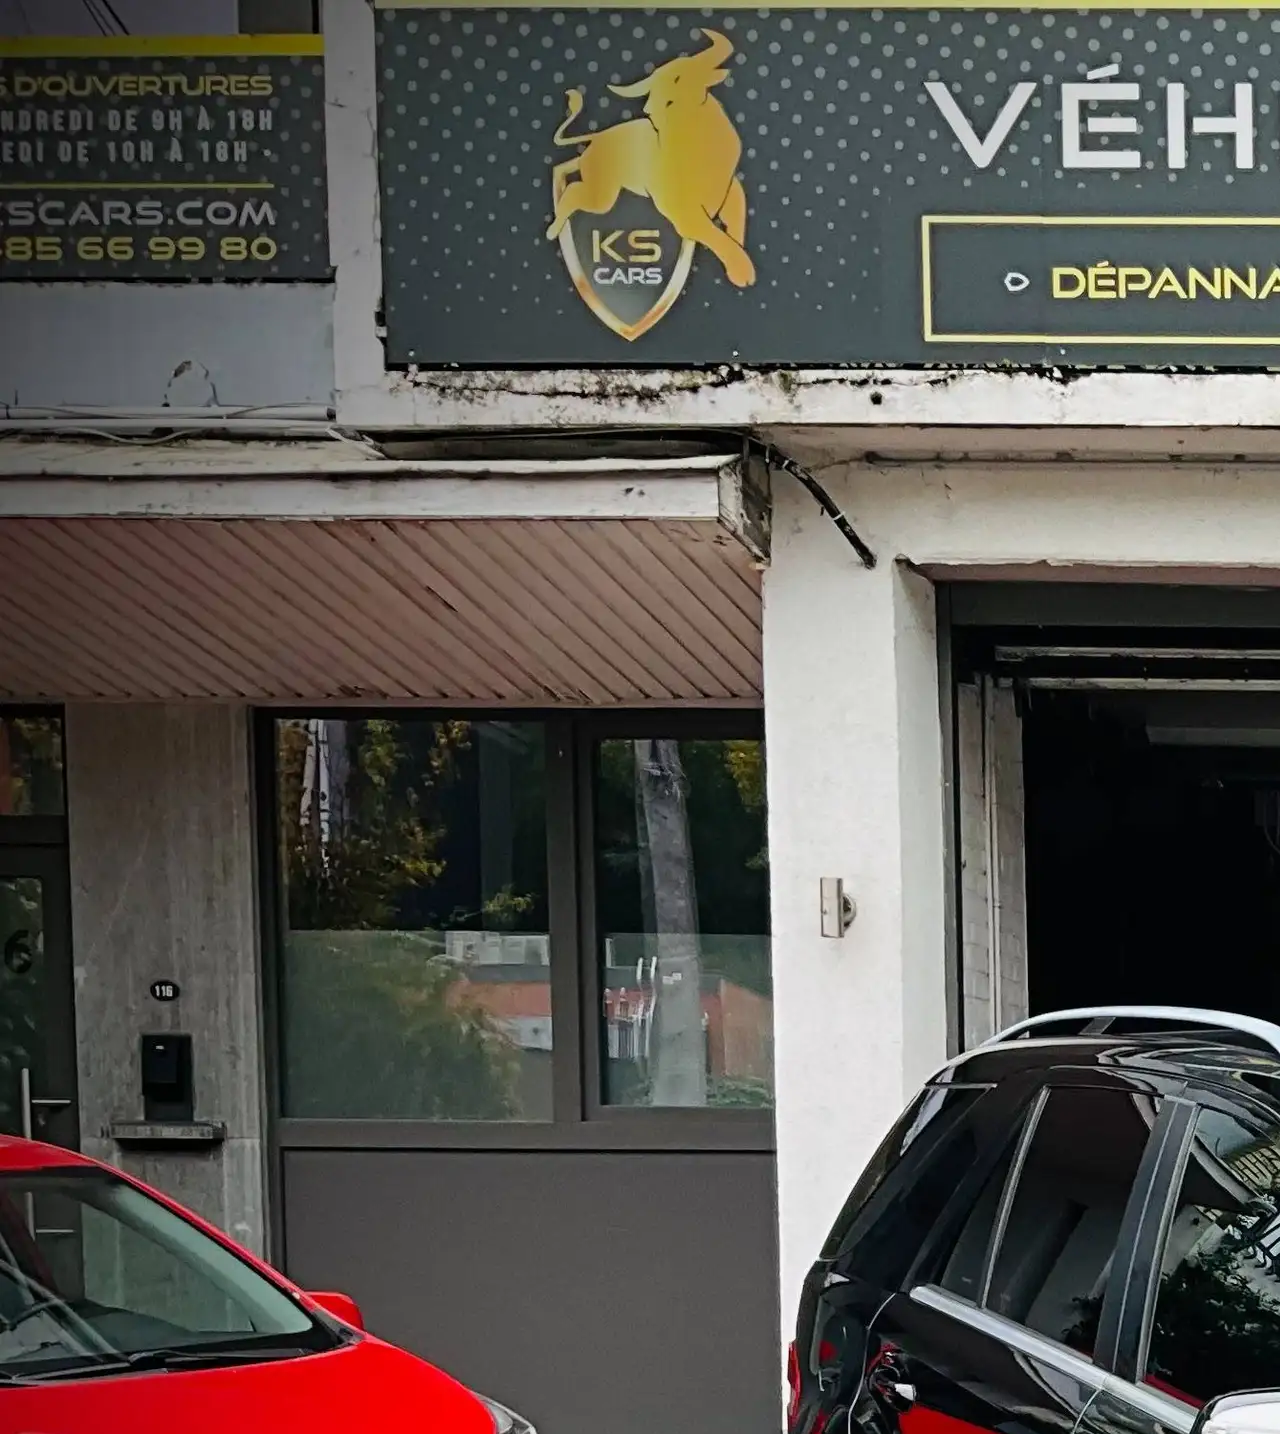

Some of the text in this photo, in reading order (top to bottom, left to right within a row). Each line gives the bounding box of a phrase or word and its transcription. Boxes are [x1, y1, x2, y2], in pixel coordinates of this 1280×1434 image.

[14, 75, 274, 97] D'OUVERTURES
[107, 109, 138, 131] DE
[151, 109, 183, 132] 9H
[197, 104, 212, 131] À
[228, 109, 273, 131] 18H
[58, 140, 89, 162] DE
[106, 140, 153, 162] 10H
[168, 137, 184, 162] À
[200, 140, 248, 162] 18H
[0, 200, 277, 227] SCARS.COM
[76, 236, 135, 261] 66
[147, 236, 206, 261] 99
[219, 236, 278, 262] 80
[592, 229, 662, 264] KS
[593, 267, 664, 286] CARS
[154, 984, 174, 998] 116
